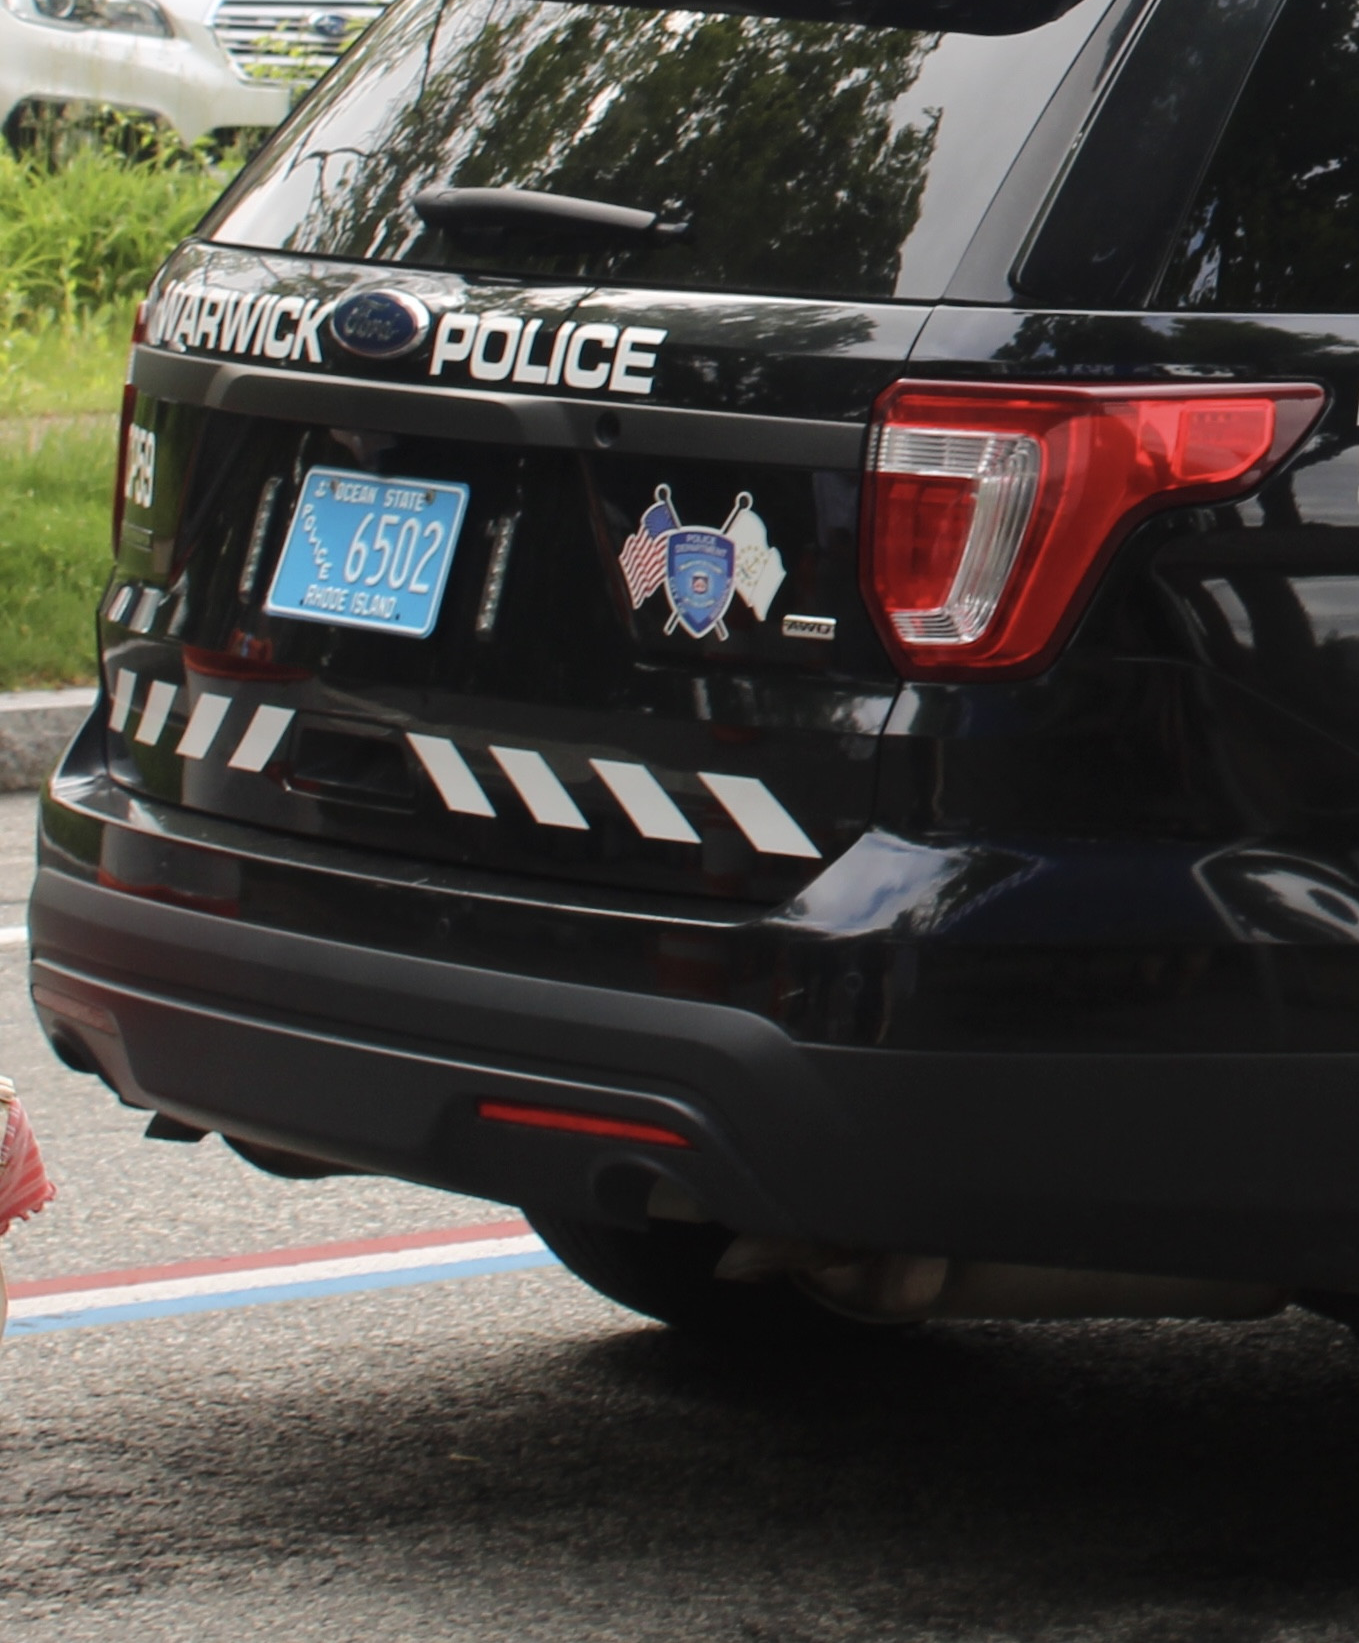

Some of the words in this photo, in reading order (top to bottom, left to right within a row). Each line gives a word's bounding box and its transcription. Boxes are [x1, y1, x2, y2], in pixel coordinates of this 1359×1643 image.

[149, 279, 335, 363] WARWICK
[429, 312, 668, 395] POLICE
[333, 481, 380, 505] OCEAN
[383, 488, 427, 513] STATE
[302, 503, 333, 582] POLICE
[343, 512, 445, 594] 6502
[303, 584, 350, 613] RHODE
[350, 591, 397, 619] ISLAND
